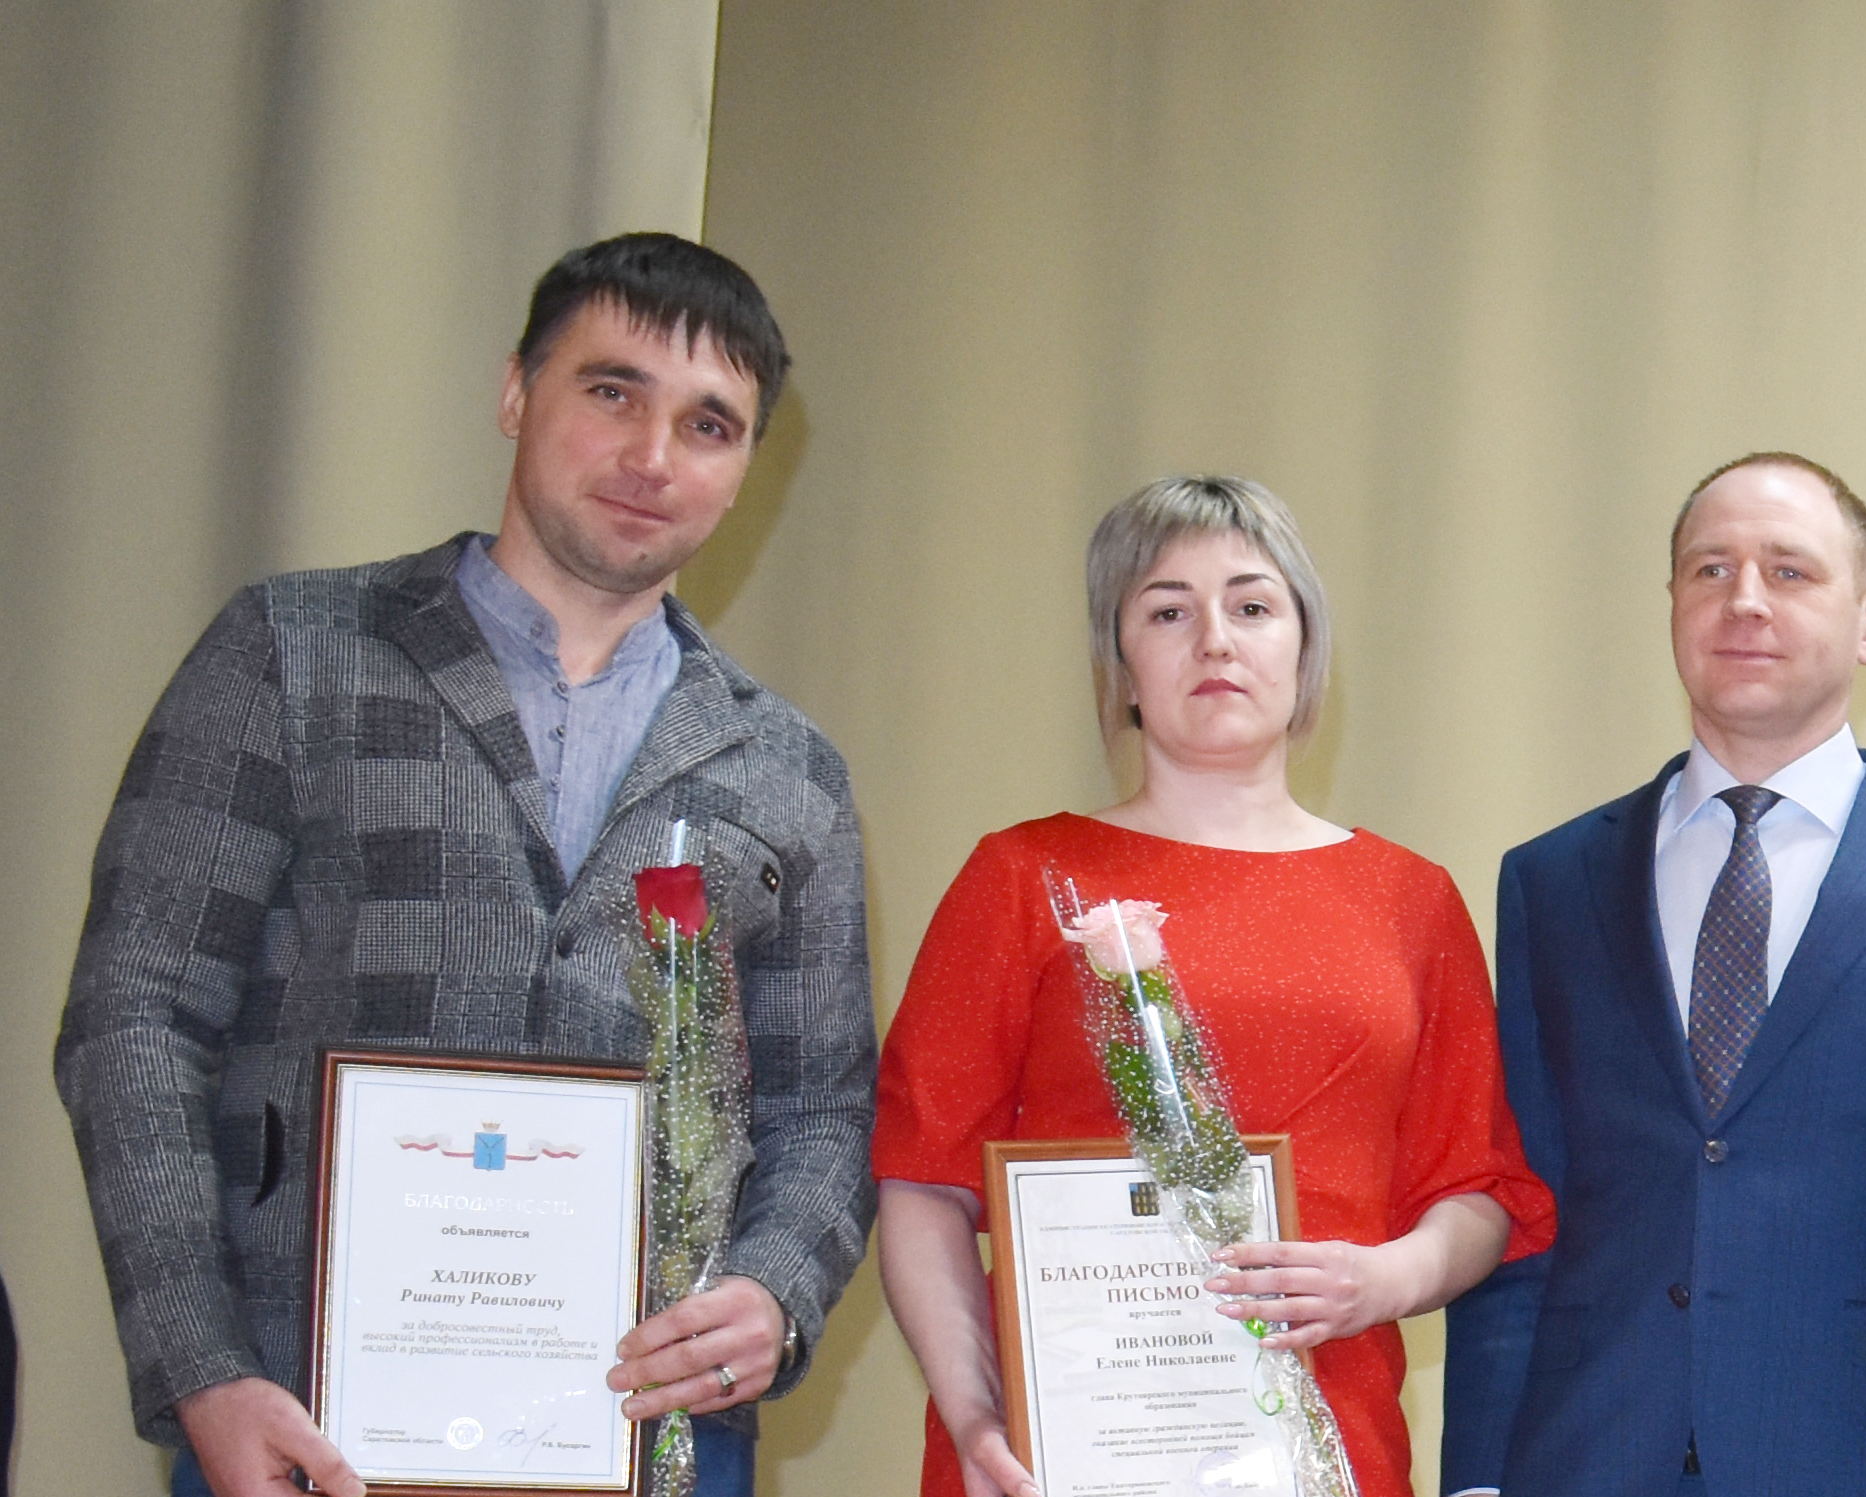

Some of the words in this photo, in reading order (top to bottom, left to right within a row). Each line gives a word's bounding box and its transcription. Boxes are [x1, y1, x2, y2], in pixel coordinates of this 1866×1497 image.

[441, 1225, 530, 1240] объявляется
[431, 1269, 537, 1287] ХАЛИКОВУ
[1040, 1261, 1203, 1283] БЛАГОДАРСТВЕ
[400, 1288, 465, 1307] Ринату
[470, 1291, 565, 1311] Равиловичу
[1107, 1285, 1200, 1303] ПИСЬМО
[1129, 1308, 1182, 1321] вручается
[402, 1321, 415, 1332] за
[418, 1319, 523, 1336] добросовестный
[362, 1331, 416, 1344] высокий
[418, 1332, 528, 1348] профессионализм
[531, 1338, 538, 1348] в
[541, 1337, 588, 1351] работе
[590, 1340, 598, 1350] и
[1115, 1330, 1214, 1350] ИВАНОВОЙ
[361, 1342, 397, 1355] вклад
[399, 1344, 407, 1354] в
[409, 1345, 469, 1358] развитие
[472, 1348, 532, 1362] сельского
[534, 1348, 599, 1363] хозяйства
